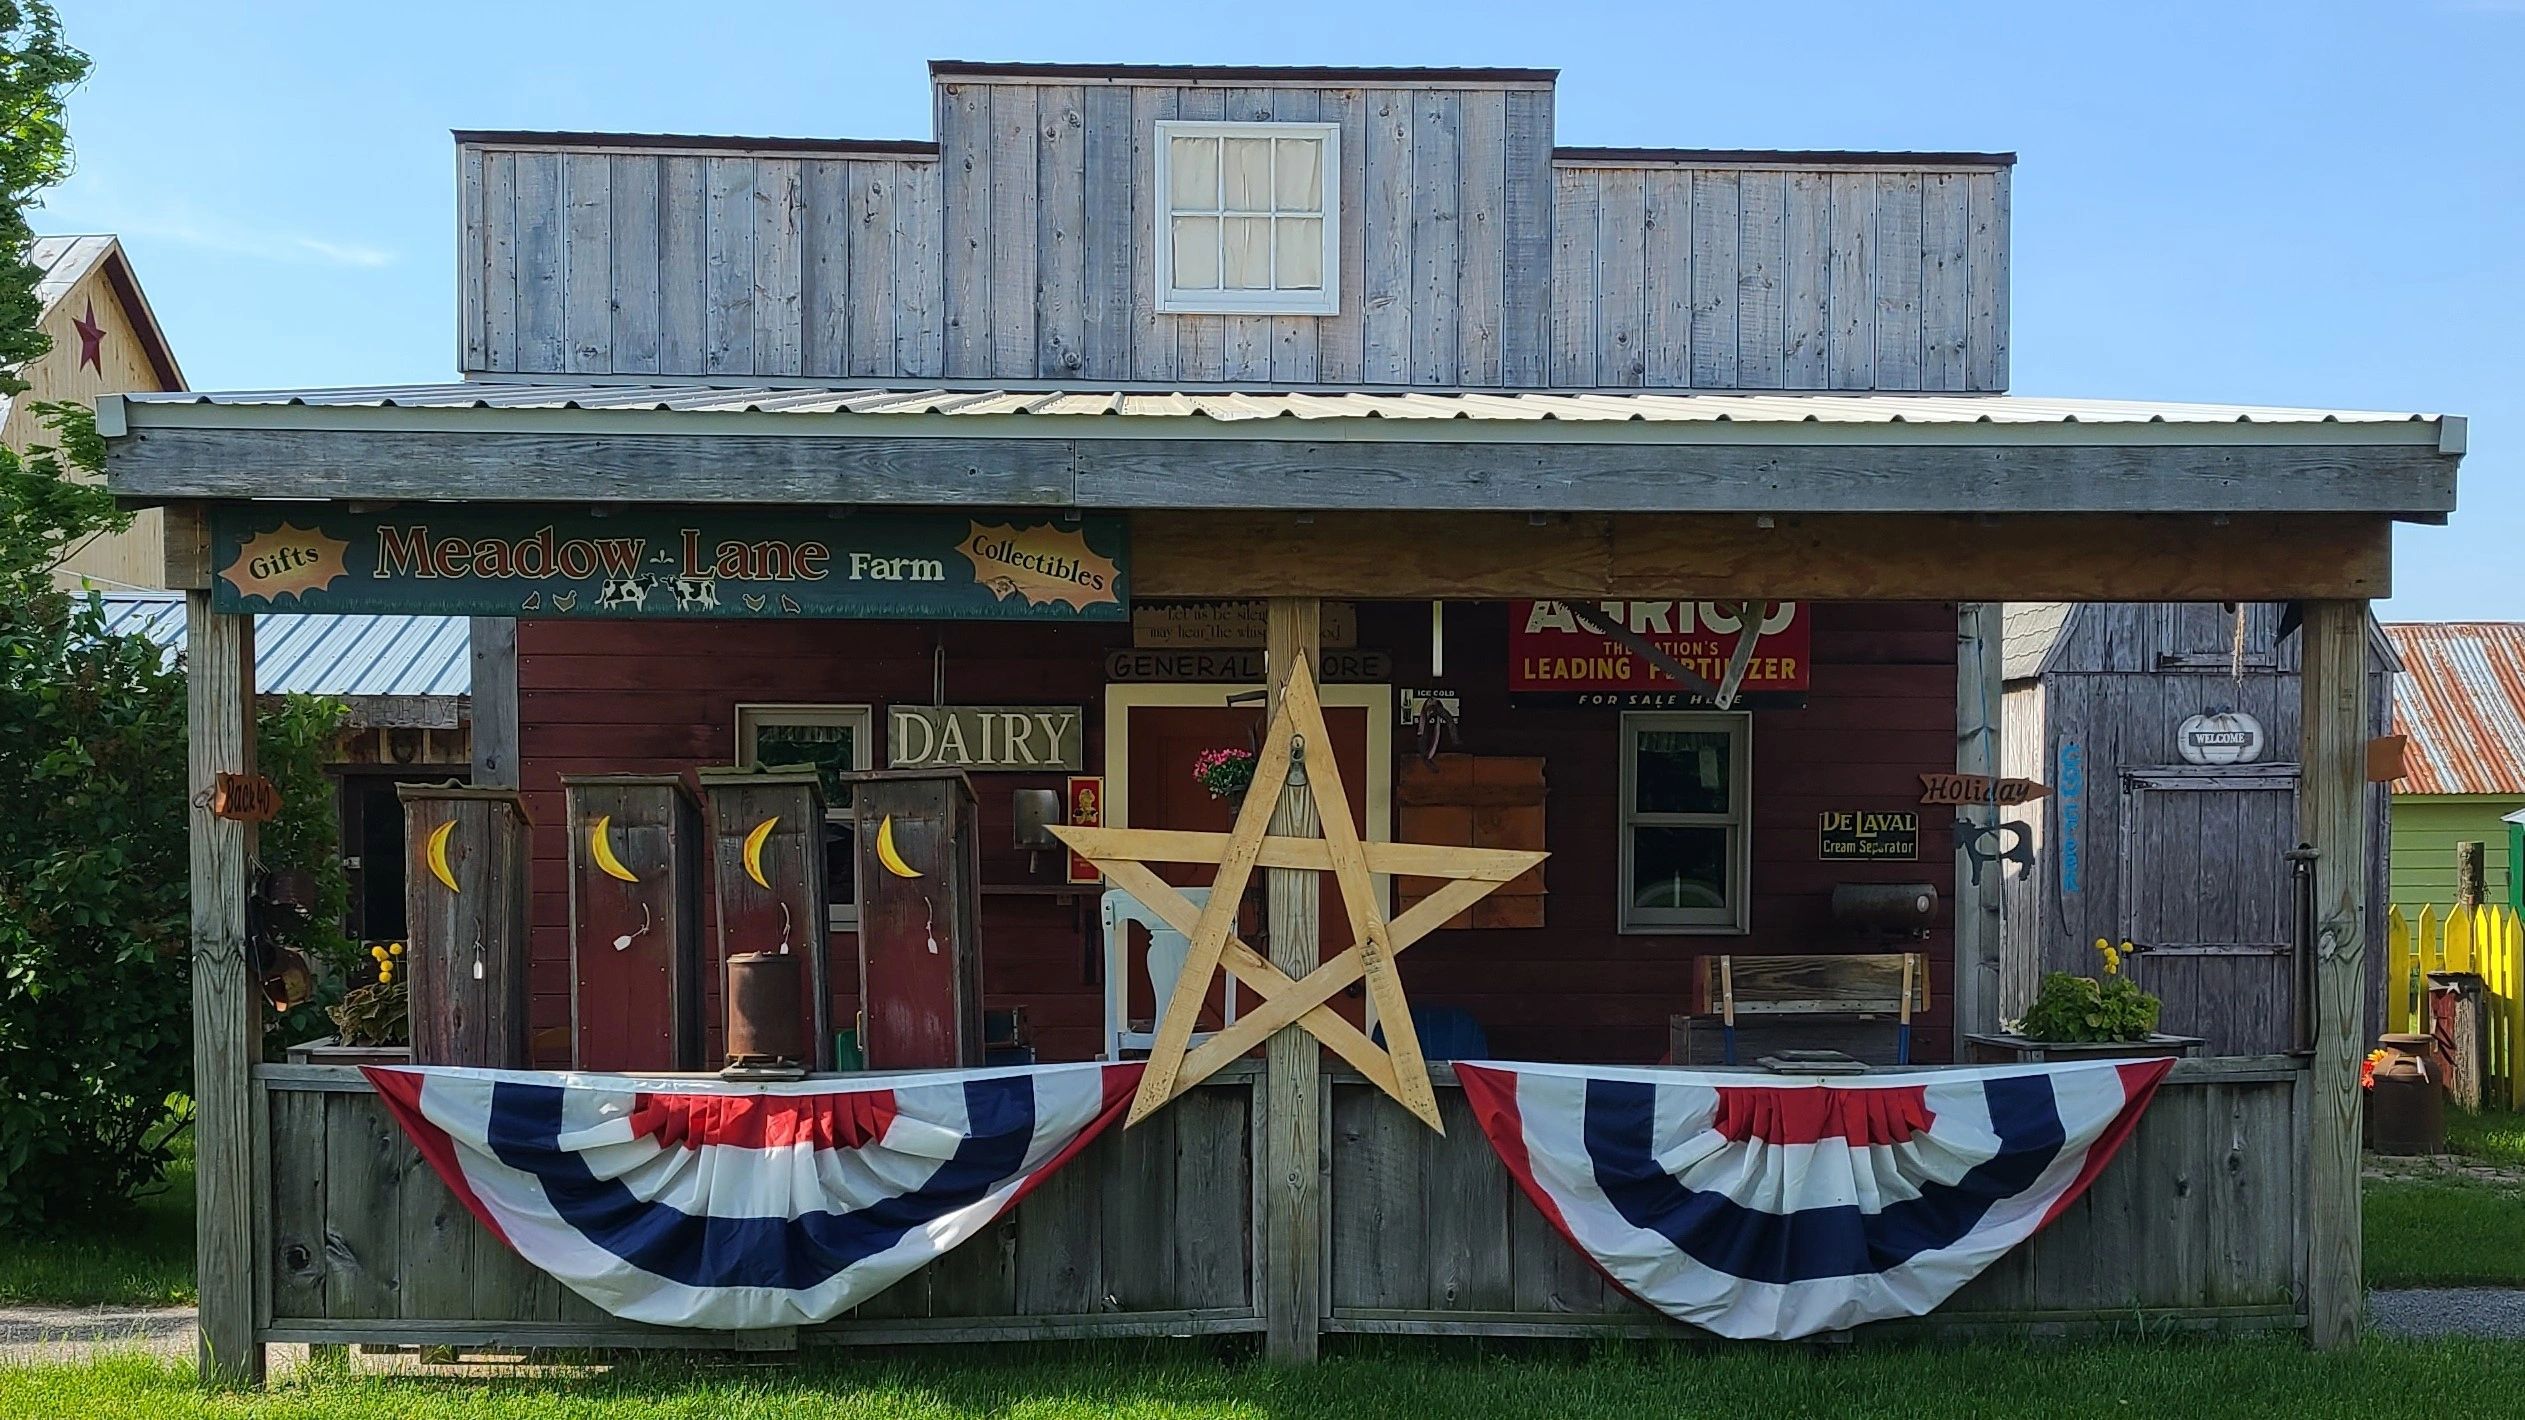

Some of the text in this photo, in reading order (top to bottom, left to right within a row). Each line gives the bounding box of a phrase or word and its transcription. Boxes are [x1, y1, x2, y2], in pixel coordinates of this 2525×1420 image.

[249, 545, 320, 581] Gifts
[374, 525, 945, 582] Meadow Lane Farm
[971, 534, 1105, 592] Collectibles
[1654, 641, 1719, 655] TION'S
[1114, 656, 1379, 678] GENERAL ORE
[1524, 657, 1631, 679] LEADING
[1579, 694, 1743, 705] FOR SALE HE
[893, 712, 1075, 764] DAIRY
[2195, 733, 2245, 744] WELCOME
[1929, 775, 2030, 802] Holiday
[1823, 840, 1856, 853] Cream
